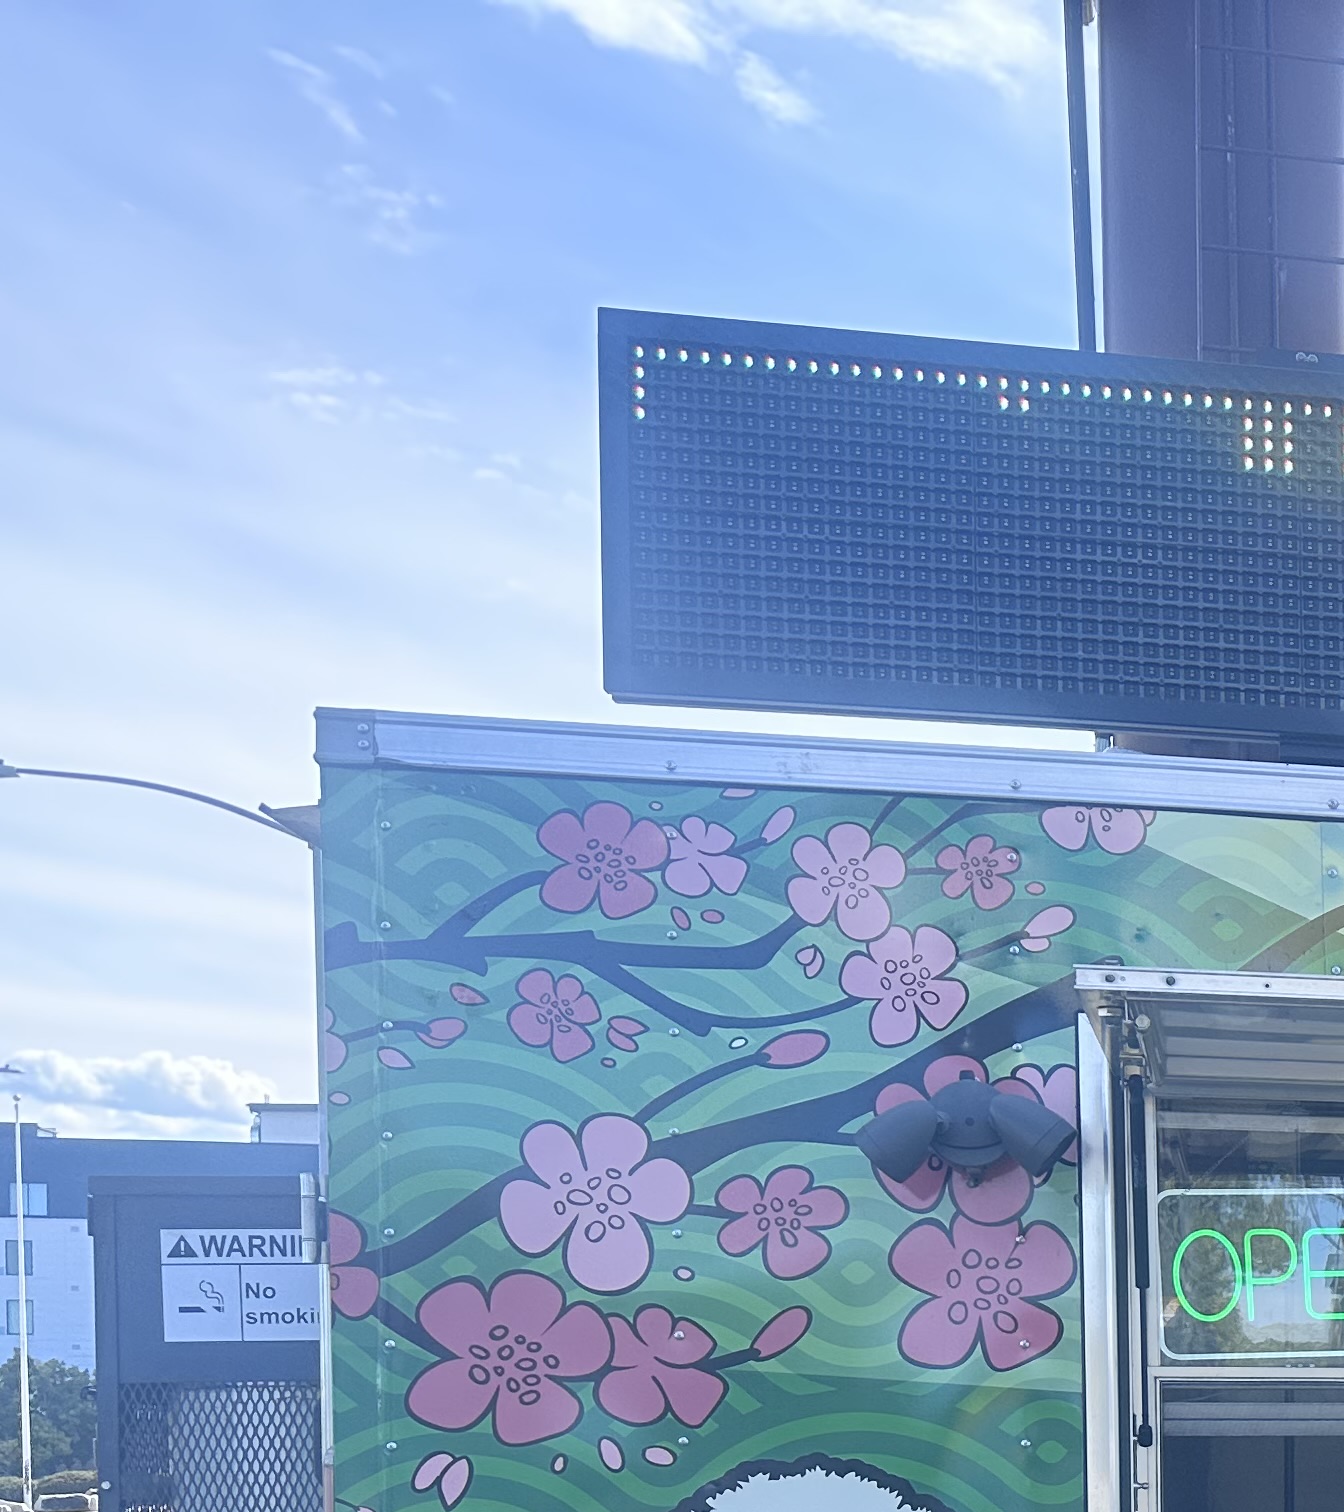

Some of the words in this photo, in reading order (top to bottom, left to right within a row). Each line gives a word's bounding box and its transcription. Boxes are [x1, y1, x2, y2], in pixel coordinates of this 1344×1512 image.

[199, 1234, 303, 1258] WARNI
[245, 1282, 276, 1299] No
[246, 1307, 320, 1325] smoki
